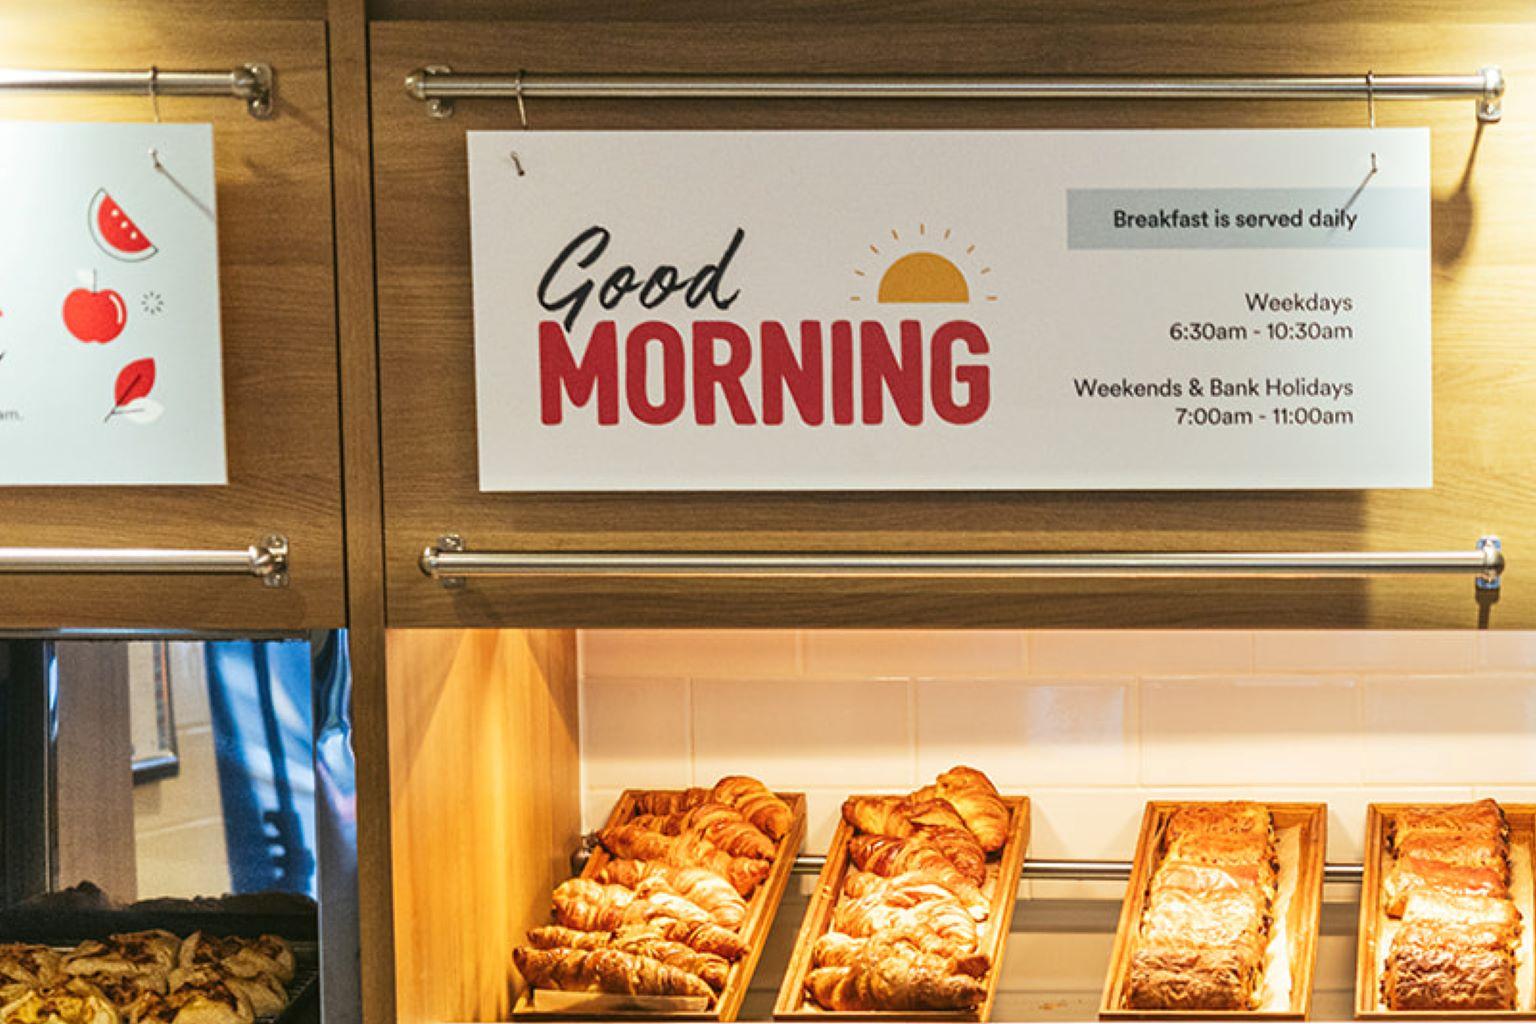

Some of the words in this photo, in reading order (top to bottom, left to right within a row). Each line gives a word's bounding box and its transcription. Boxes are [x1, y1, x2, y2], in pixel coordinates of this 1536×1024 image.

[1113, 209, 1209, 229] Breakfast
[1214, 209, 1230, 229] is
[1235, 209, 1303, 229] served
[1309, 208, 1358, 231] daily
[537, 225, 746, 334] Good
[1244, 293, 1354, 315] Weekdays
[1169, 322, 1248, 341] 6:30am
[1267, 322, 1354, 341] 10:30am
[538, 320, 991, 427] MORNING
[1073, 378, 1183, 398] Weekends
[1188, 379, 1204, 398] &
[1210, 378, 1260, 398] Bank
[1265, 378, 1354, 404] Holidays
[1175, 407, 1253, 425] 7:00am
[1272, 407, 1354, 425] 11:00am
